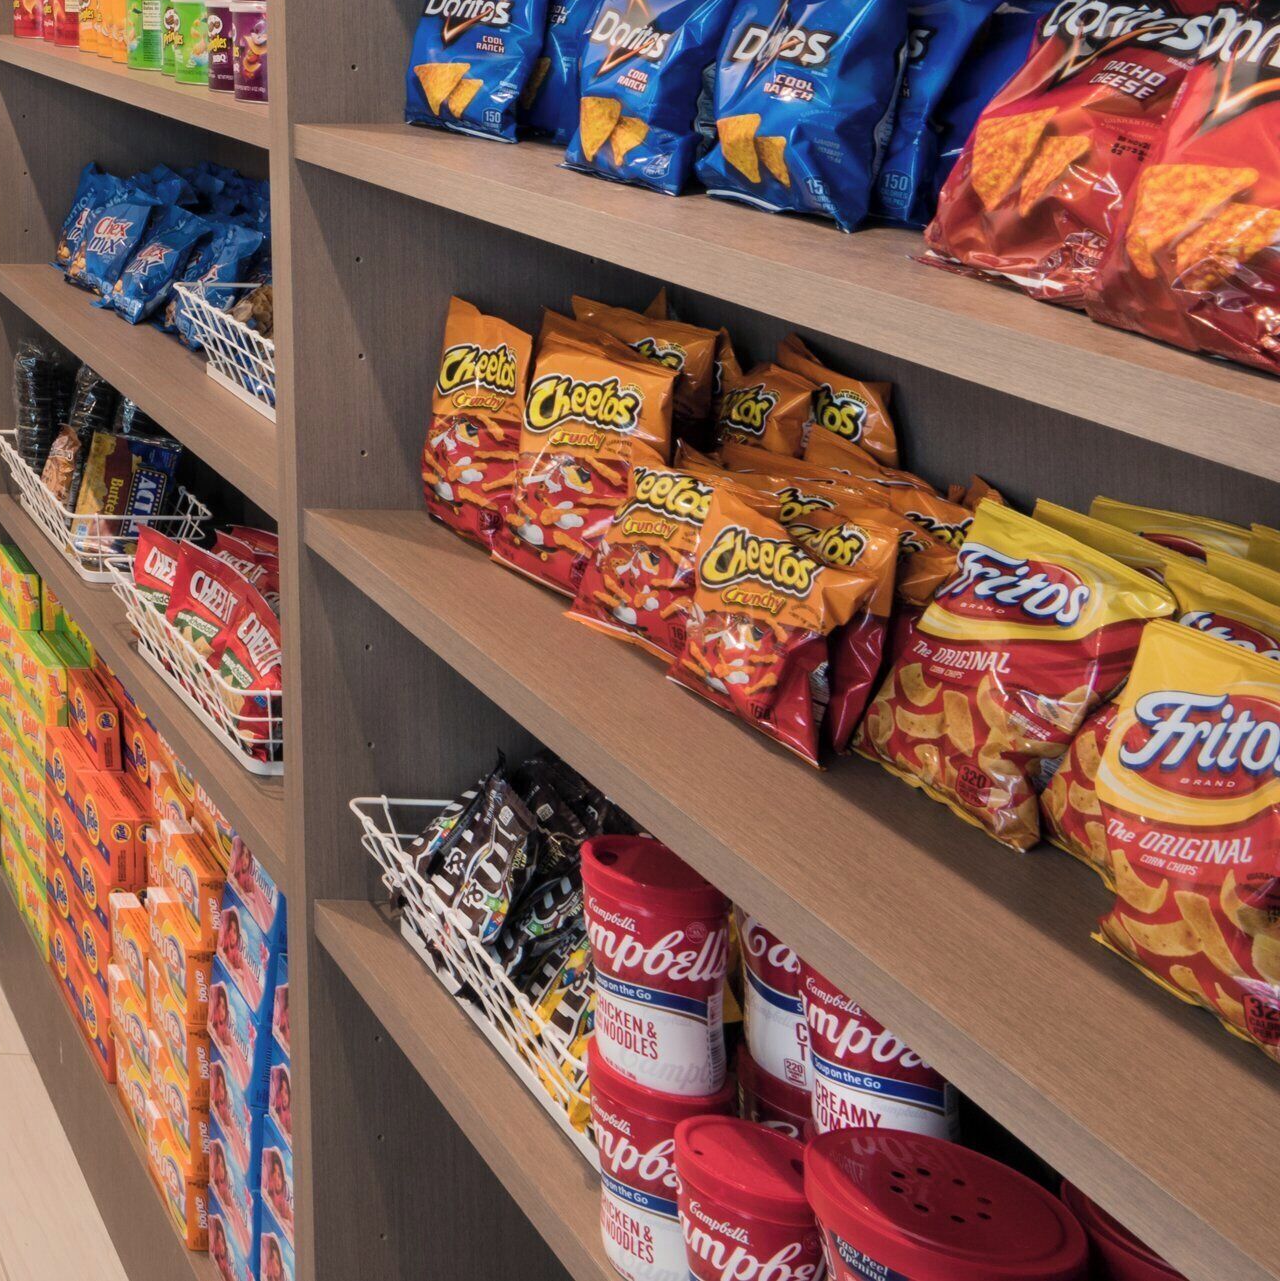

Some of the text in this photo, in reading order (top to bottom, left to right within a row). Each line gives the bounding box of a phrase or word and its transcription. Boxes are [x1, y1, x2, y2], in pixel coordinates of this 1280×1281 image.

[476, 42, 505, 54] RANCH
[482, 35, 504, 46] COOL
[591, 10, 671, 60] Doritos
[734, 26, 832, 64] Doos
[212, 53, 228, 64] BBQ
[1103, 58, 1167, 89] NACHO
[617, 75, 647, 93] RANCH
[627, 68, 649, 83] COOL
[775, 73, 815, 92] COOL
[1088, 70, 1157, 101] CHEESE
[485, 111, 502, 124] 150
[883, 172, 909, 192] 150
[94, 216, 130, 237] Chex
[439, 345, 517, 394] Cheetos
[452, 390, 505, 410] Crunchy
[525, 375, 641, 431] Cheetos
[549, 427, 606, 450] Crunchy
[135, 475, 157, 515] ACT
[630, 472, 712, 523] eetos
[621, 516, 678, 541] Crunchy
[700, 527, 818, 596] Cheetos
[720, 584, 787, 615] Crunchy
[935, 542, 1091, 628] Fritos
[959, 601, 1006, 615] BRAND
[911, 639, 1011, 674] The ORIGINAL
[929, 665, 966, 679] CORN CHIPS
[1119, 690, 1280, 772] Frito
[961, 766, 987, 789] 320
[1179, 776, 1237, 790] BRAND
[1106, 817, 1253, 866] The ORIGINAL
[1139, 854, 1199, 877] CORN CHIPS
[589, 896, 637, 933] Campbell's
[585, 920, 728, 983] mpbell's
[195, 969, 208, 1003] bounce
[620, 983, 635, 997] the
[636, 988, 652, 1001] Go
[806, 975, 862, 1018] Campbell's
[603, 1020, 658, 1060] NOODLES
[646, 1020, 658, 1040] &
[197, 1046, 210, 1080] bounce
[786, 1059, 803, 1075] 220
[831, 1068, 842, 1079] on
[843, 1070, 862, 1086] the
[863, 1076, 882, 1091] Go
[591, 1095, 632, 1137] Campbell's
[815, 1078, 882, 1129] CREAMY
[618, 1184, 649, 1206] the Go
[195, 1196, 209, 1230] bounce
[689, 1200, 750, 1246] Campbell's
[644, 1224, 654, 1244] &
[836, 1234, 889, 1275] Easy Peel
[838, 1247, 887, 1281] Opening
